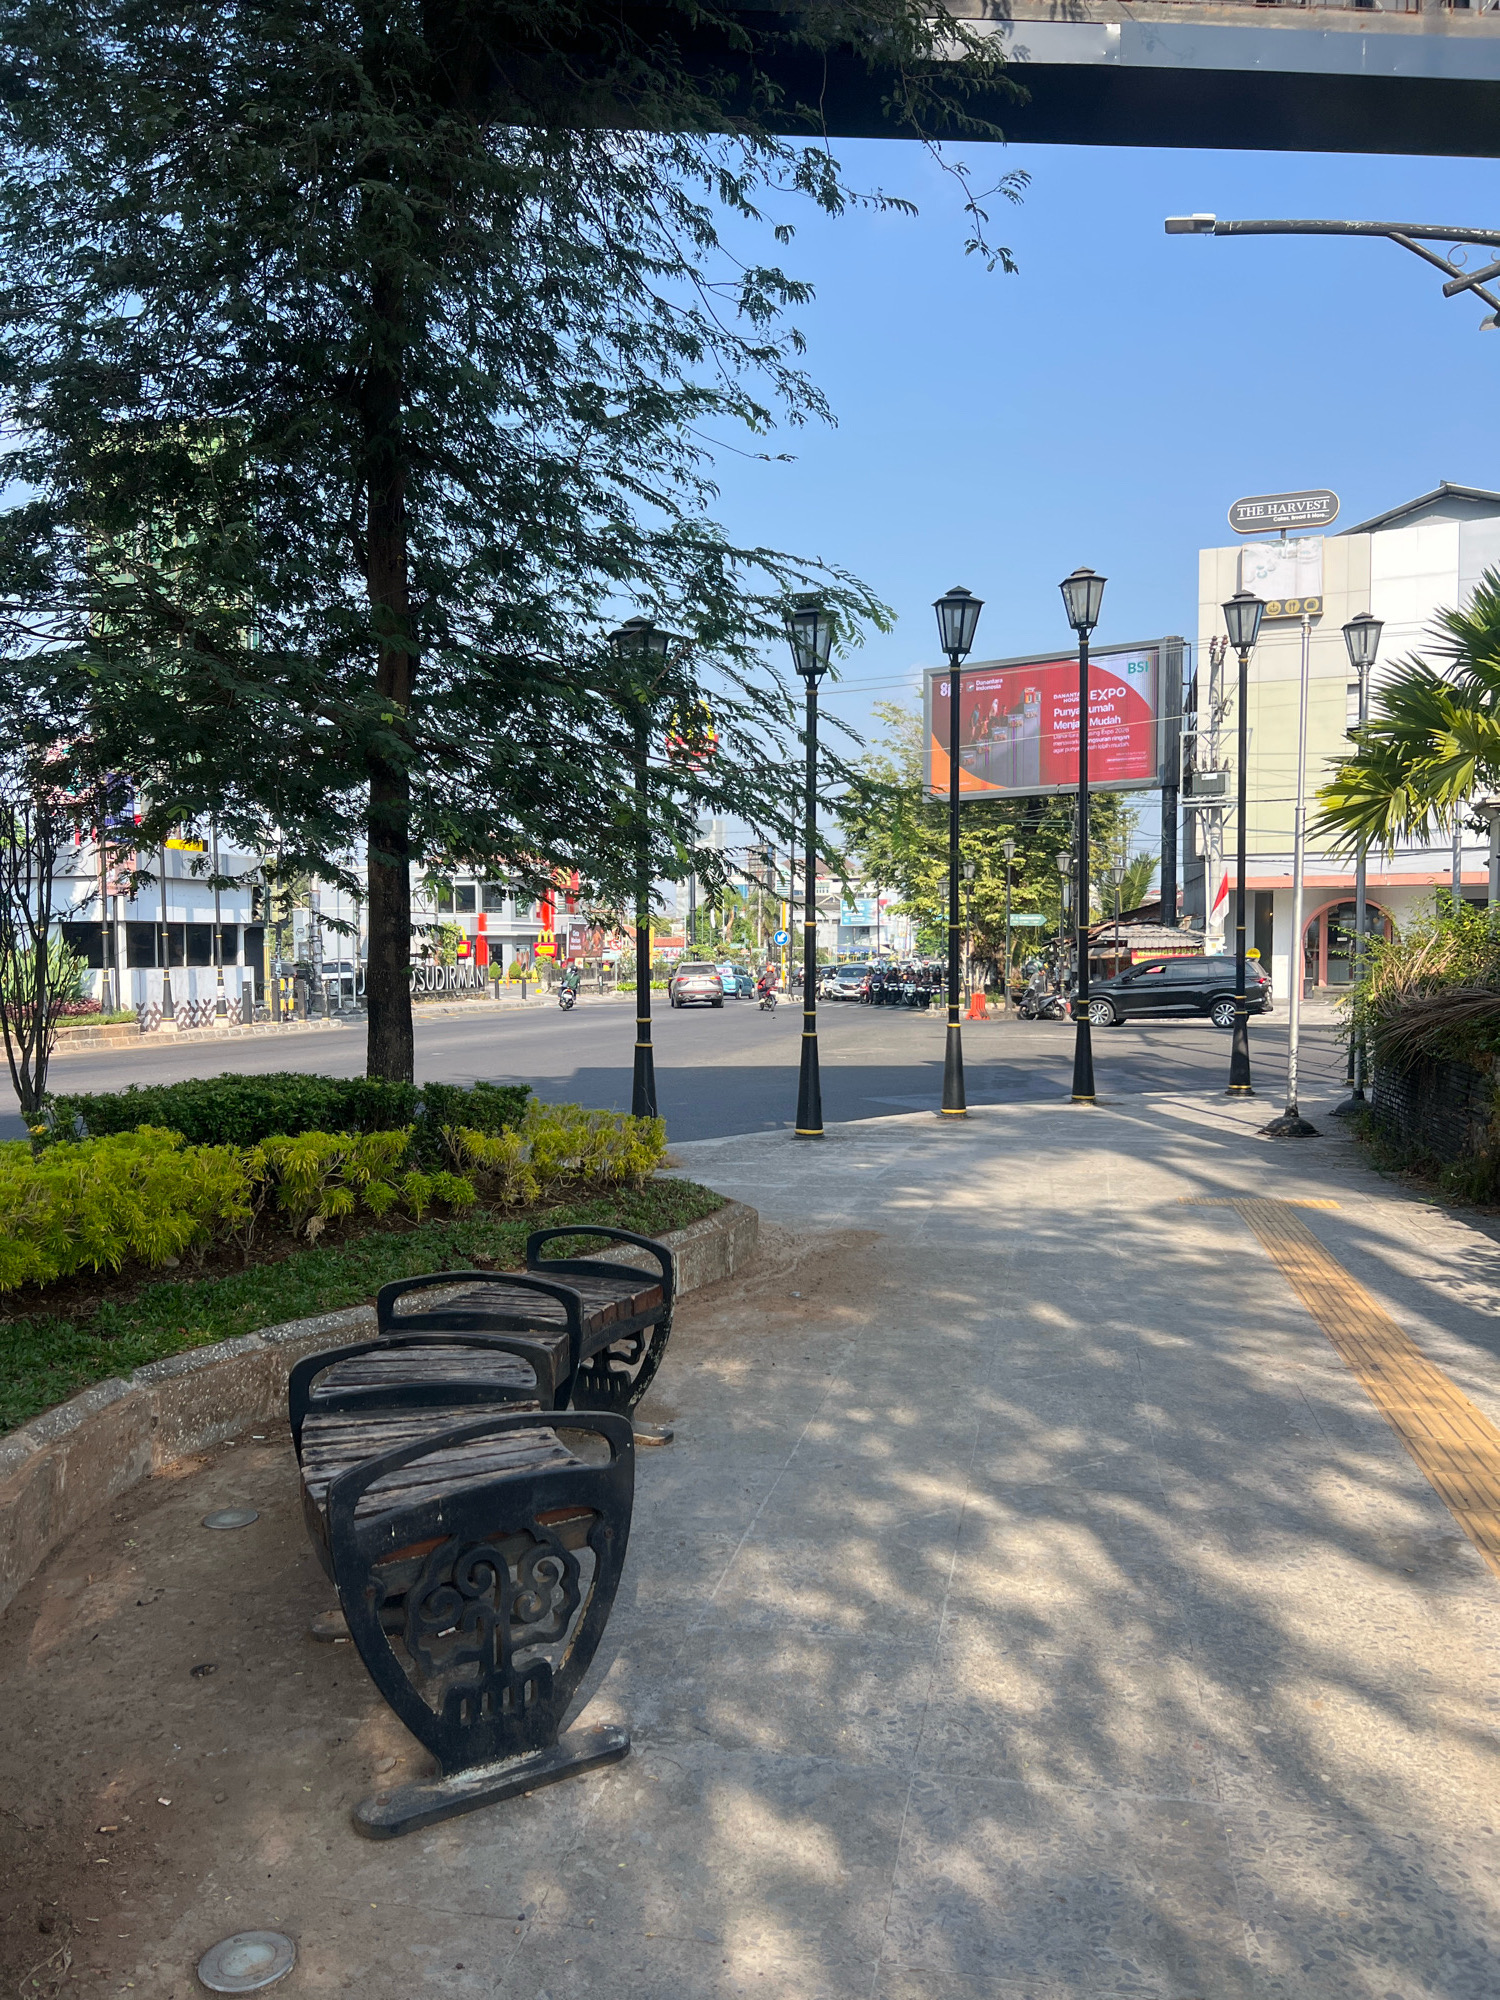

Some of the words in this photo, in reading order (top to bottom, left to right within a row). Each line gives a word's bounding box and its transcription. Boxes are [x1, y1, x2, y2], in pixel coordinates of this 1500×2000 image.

[1237, 505, 1264, 517] THE
[1267, 499, 1330, 515] HARVEST
[1127, 661, 1148, 674] BSI
[975, 678, 1003, 686] Danantara
[1090, 687, 1126, 701] EXPO
[1053, 707, 1080, 717] Punya
[1088, 703, 1114, 714] umah
[1053, 719, 1080, 730] Menja
[1089, 715, 1121, 726] Mudah
